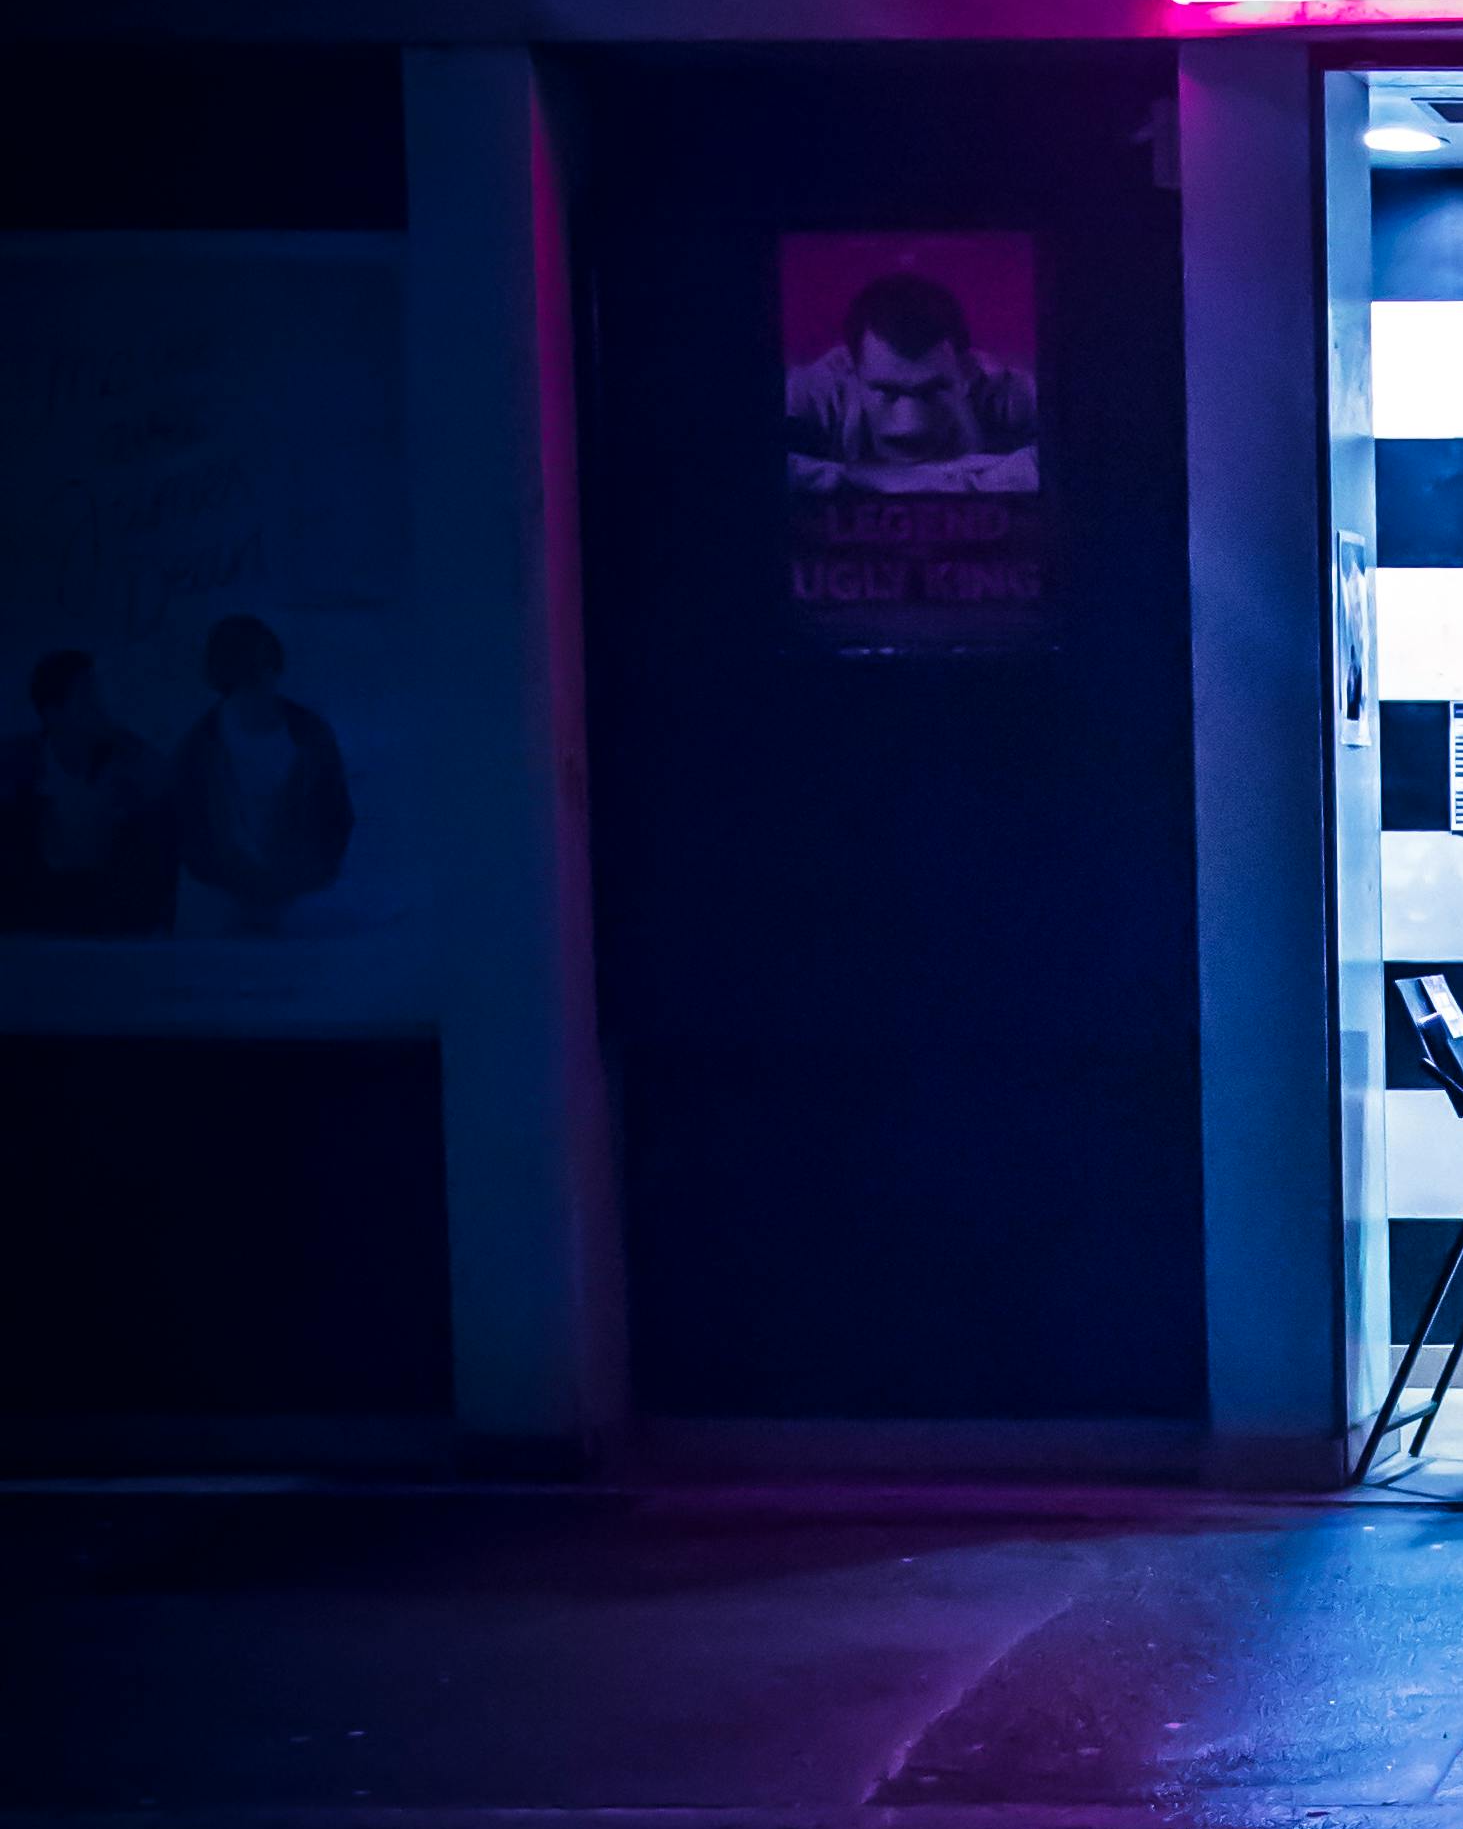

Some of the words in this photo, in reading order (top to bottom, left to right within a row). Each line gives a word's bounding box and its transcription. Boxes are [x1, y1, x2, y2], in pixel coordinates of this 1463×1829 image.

[825, 504, 1011, 542] LEGEND
[790, 560, 909, 601] UGLY
[924, 560, 1041, 601] KING
